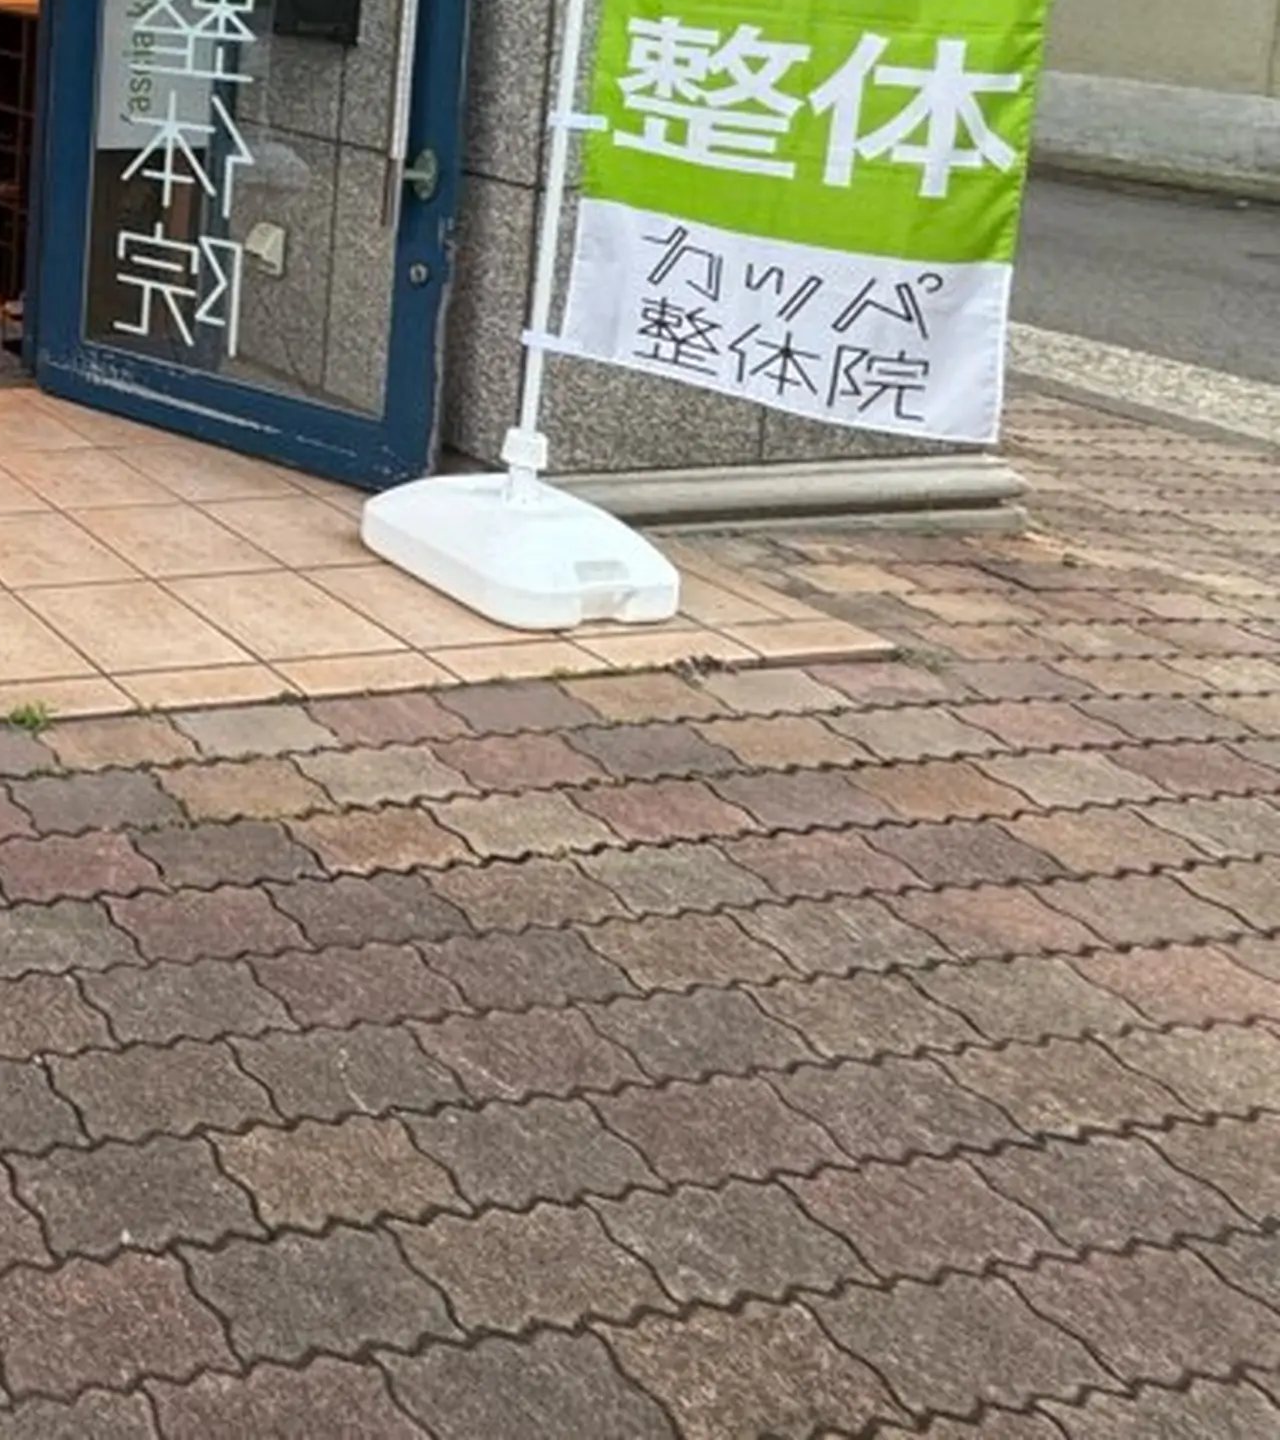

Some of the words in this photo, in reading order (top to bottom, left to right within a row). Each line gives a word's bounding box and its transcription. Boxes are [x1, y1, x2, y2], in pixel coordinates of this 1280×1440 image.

[612, 16, 1023, 199] 整体
[642, 224, 944, 341] カッパ
[633, 296, 930, 423] 整体院
